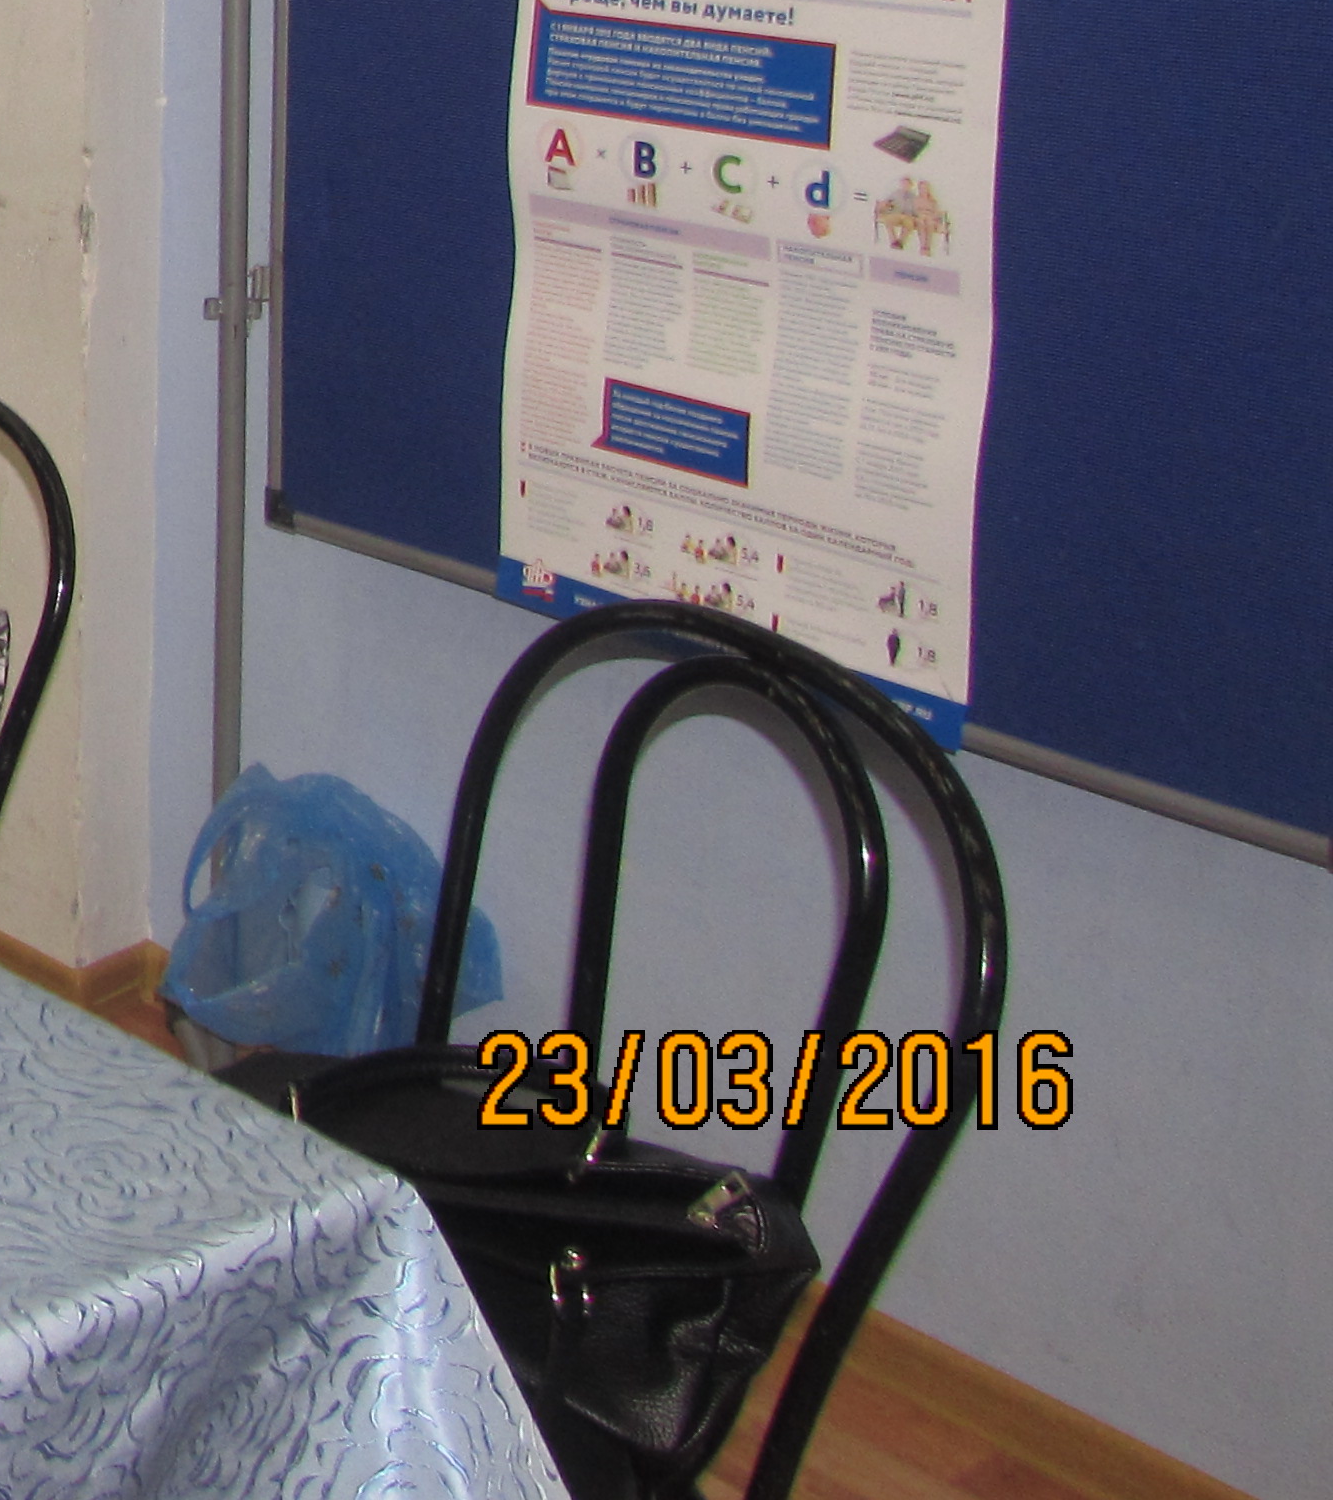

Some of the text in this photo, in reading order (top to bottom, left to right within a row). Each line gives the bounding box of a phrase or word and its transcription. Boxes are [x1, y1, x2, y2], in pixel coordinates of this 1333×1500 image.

[671, 0, 697, 15] вы
[703, 2, 794, 26] думаете!
[545, 128, 830, 208] A B C d
